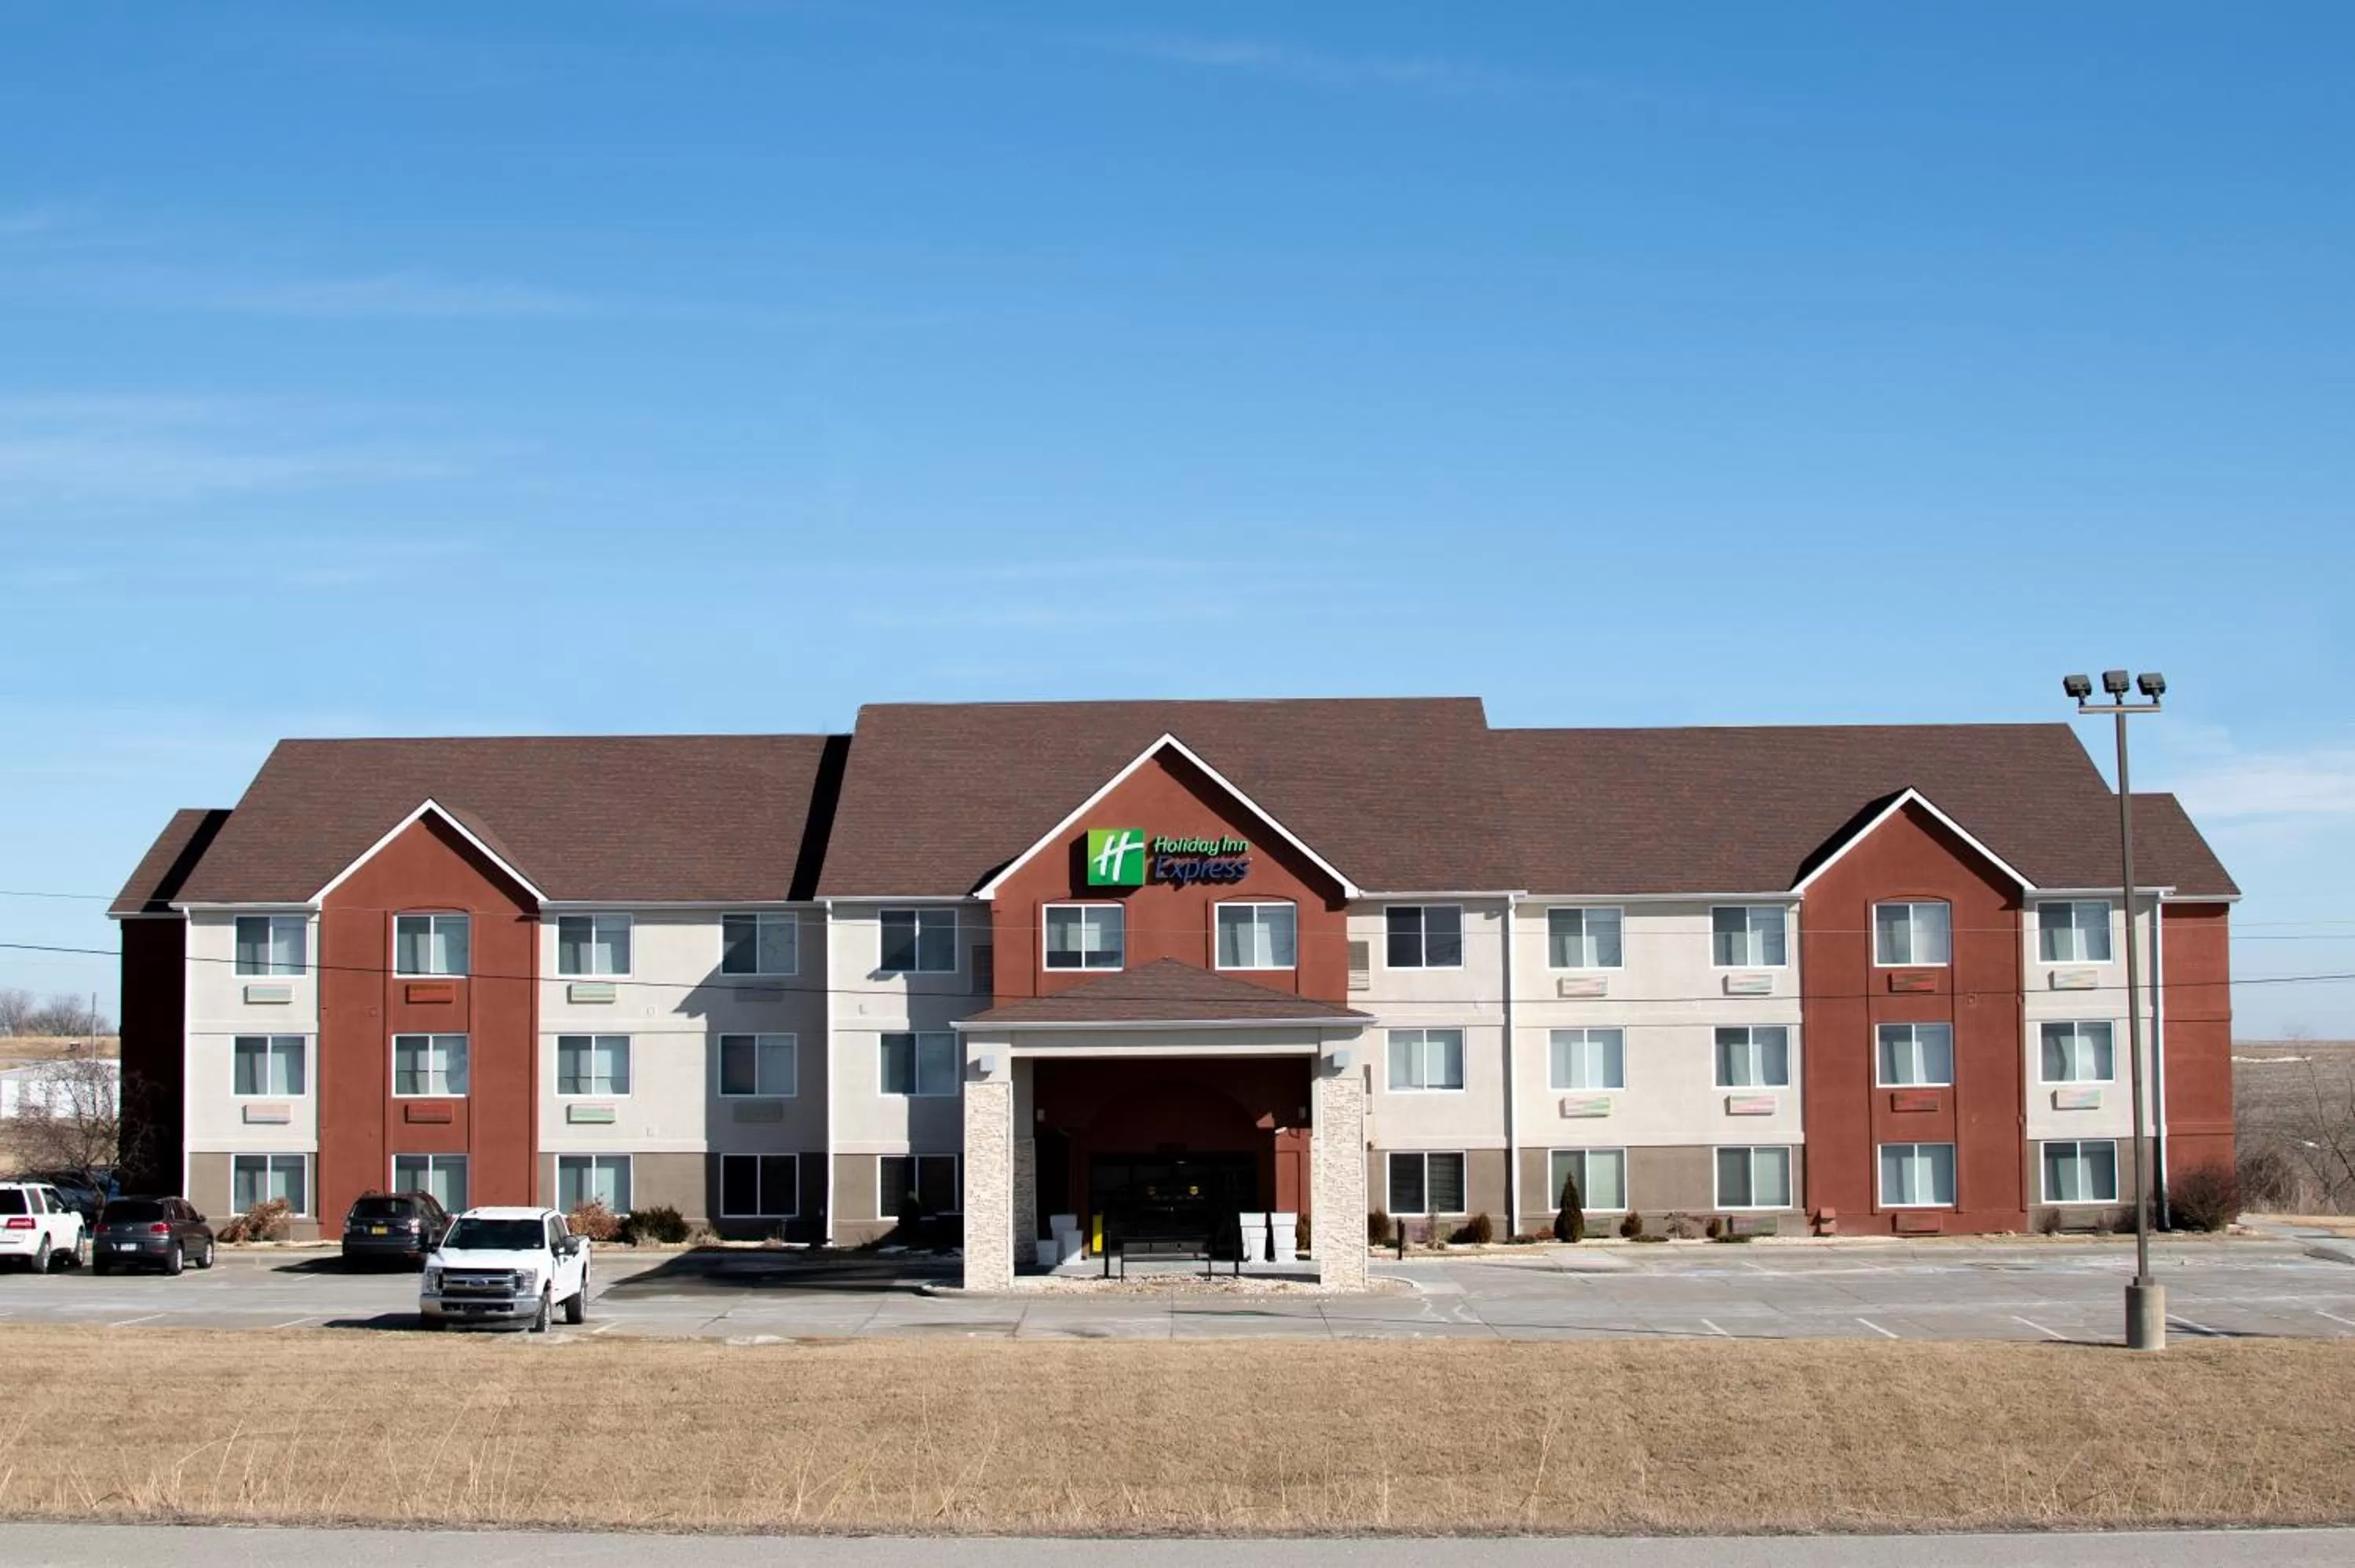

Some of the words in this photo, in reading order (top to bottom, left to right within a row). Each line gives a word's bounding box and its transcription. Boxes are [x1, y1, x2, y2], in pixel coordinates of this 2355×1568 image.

[1093, 831, 1144, 881] H
[1155, 835, 1219, 856] Holiday
[1222, 834, 1249, 851] Inn
[1155, 855, 1251, 883] Express
